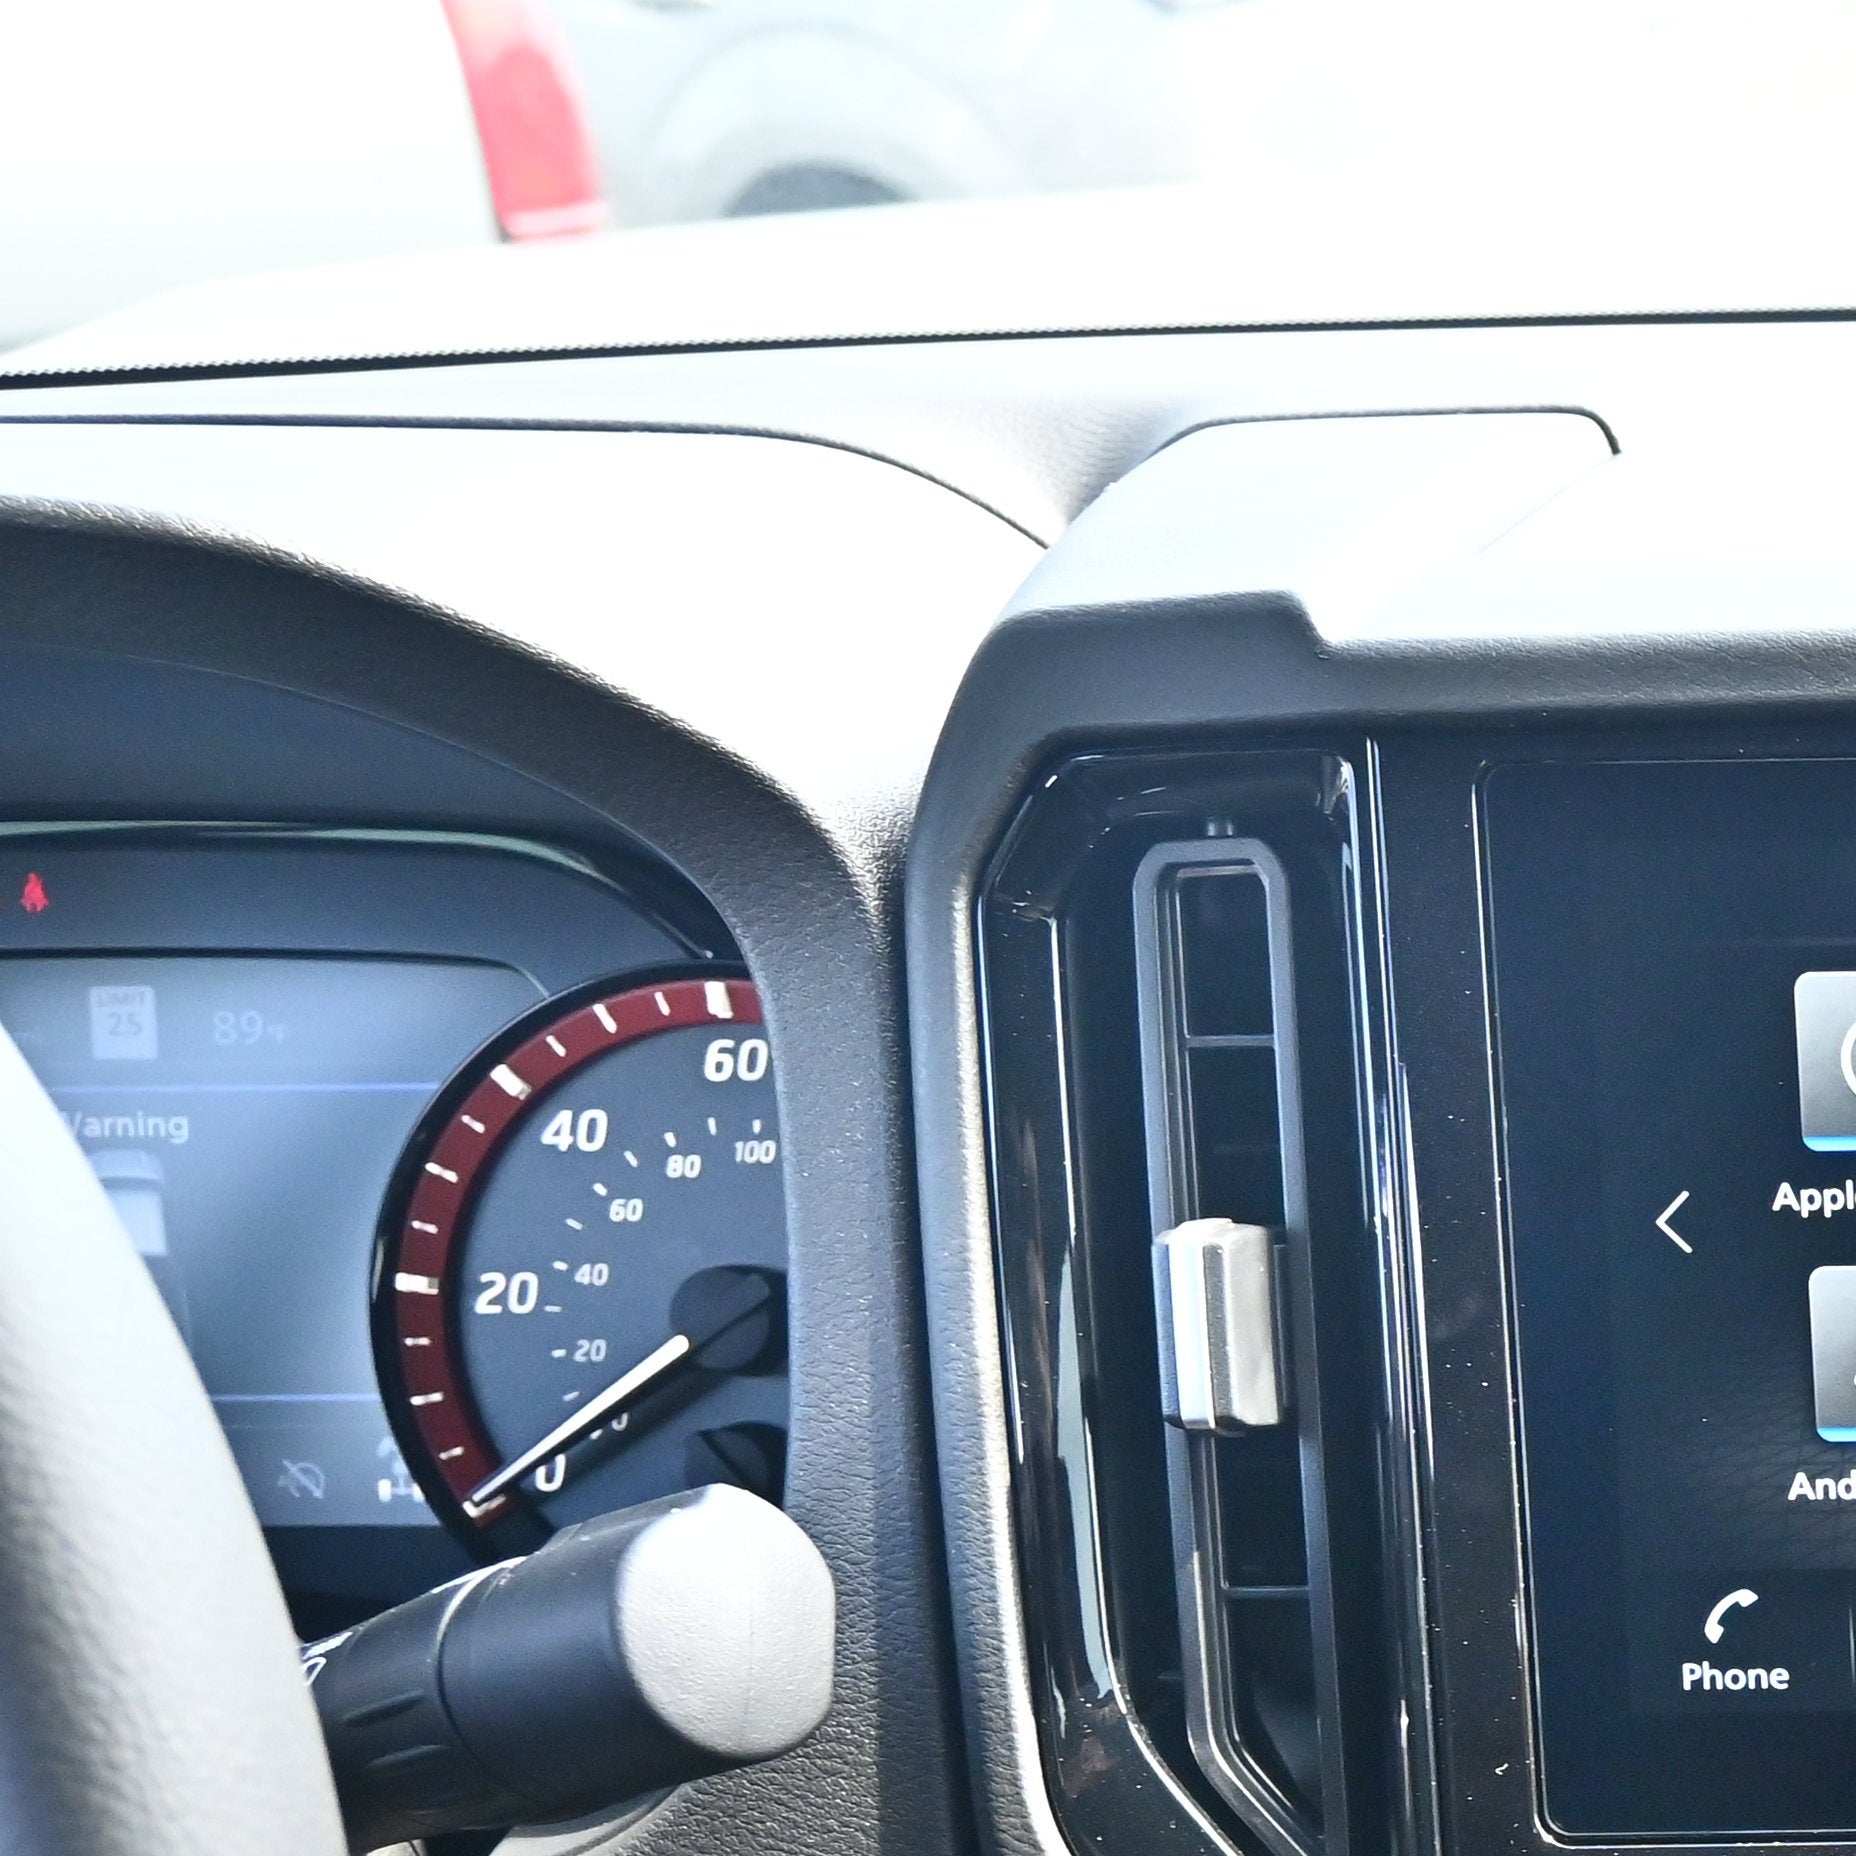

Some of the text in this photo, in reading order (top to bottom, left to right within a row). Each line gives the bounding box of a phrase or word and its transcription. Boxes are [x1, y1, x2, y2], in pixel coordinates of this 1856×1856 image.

[107, 1012, 143, 1037] 25
[704, 1039, 768, 1082] 60
[541, 1109, 608, 1152] 40
[735, 1140, 777, 1164] 100
[666, 1154, 702, 1178] 80
[609, 1198, 643, 1222] 60
[574, 1263, 609, 1286] 40
[474, 1272, 539, 1314] 20
[573, 1339, 607, 1362] 20
[1682, 1661, 1790, 1691] Phone
